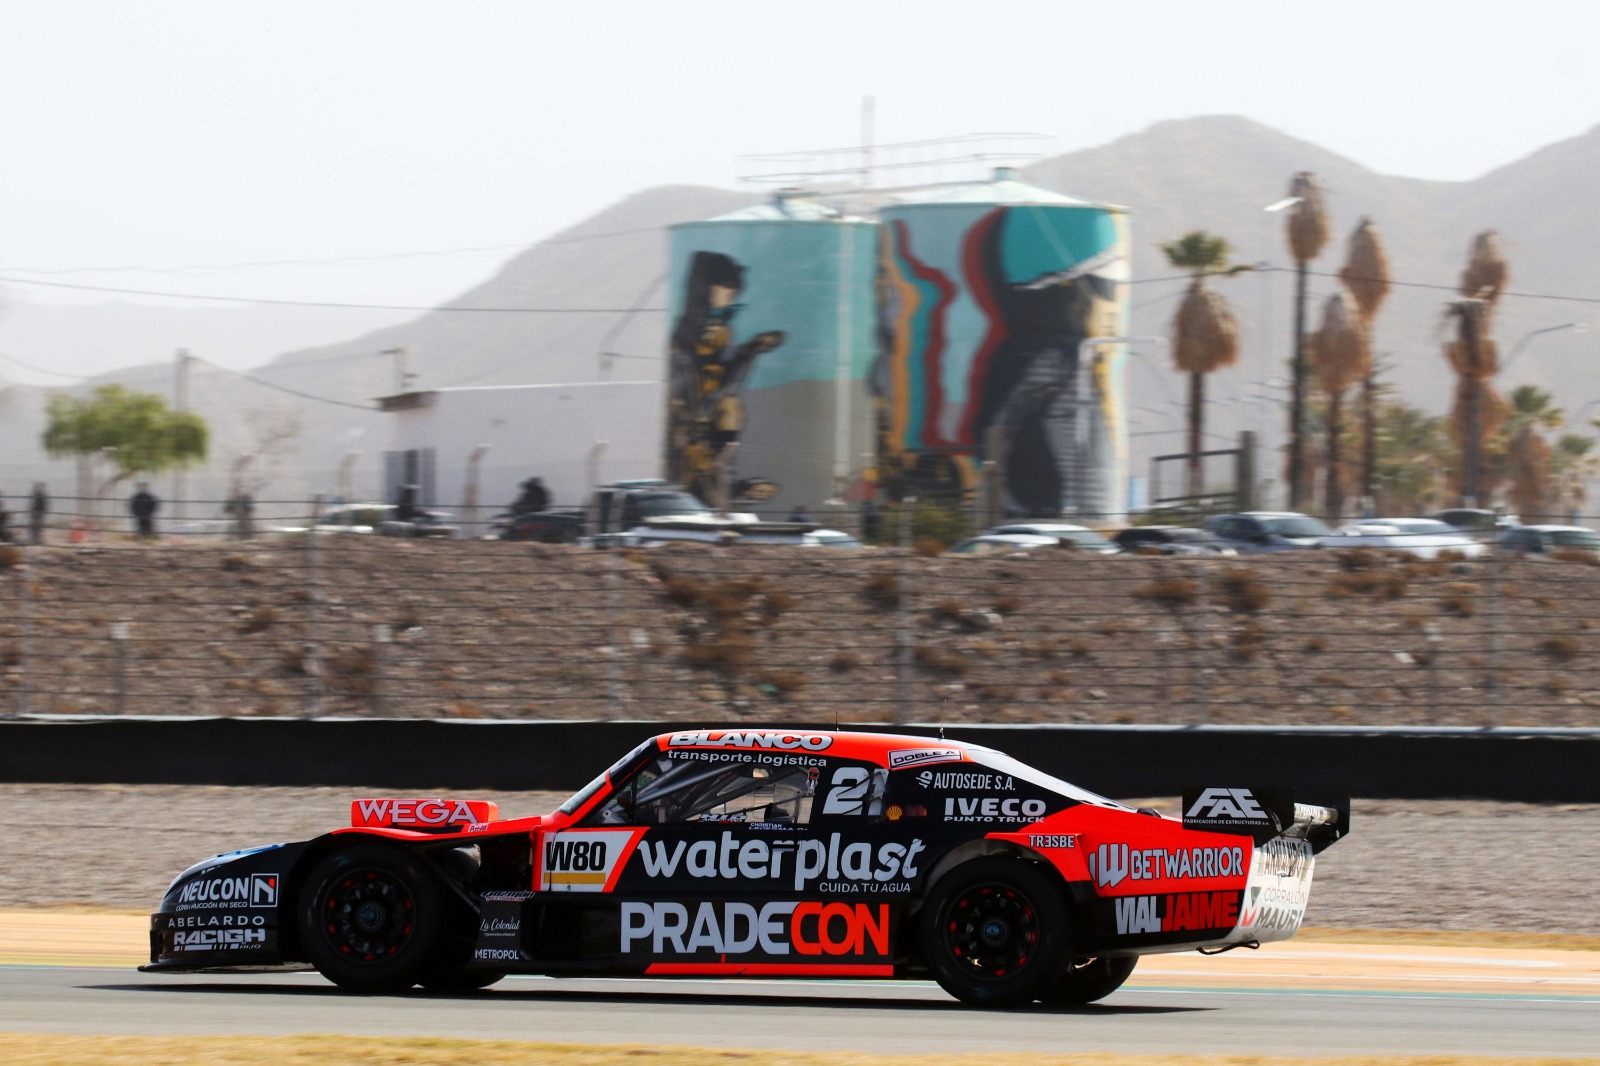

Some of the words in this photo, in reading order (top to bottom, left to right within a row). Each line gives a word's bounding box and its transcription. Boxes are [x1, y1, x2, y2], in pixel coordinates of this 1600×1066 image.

[669, 732, 834, 751] BLANCO
[667, 750, 827, 767] transporte.logística
[893, 751, 942, 764] DOBLE
[822, 766, 890, 816] 21
[934, 772, 992, 790] AUTOSEDE
[994, 775, 1016, 791] S.A.
[358, 800, 478, 824] WEGA
[944, 797, 1047, 817] IVECO
[1185, 787, 1268, 819] FAE
[545, 841, 607, 871] W80
[637, 831, 926, 891] waterplast
[1130, 846, 1245, 880] BETWARRIOR
[179, 877, 250, 903] NEUCON
[819, 882, 859, 893] CUIDA
[880, 882, 911, 893] AGUA
[218, 901, 229, 909] EN
[229, 901, 248, 909] SECO
[1114, 895, 1162, 935] VIAL
[1161, 891, 1239, 932] JAIME
[168, 915, 265, 928] ABELARDO
[490, 916, 520, 931] Colonial
[620, 901, 890, 956] PRADECON
[475, 948, 519, 960] METROPOL
